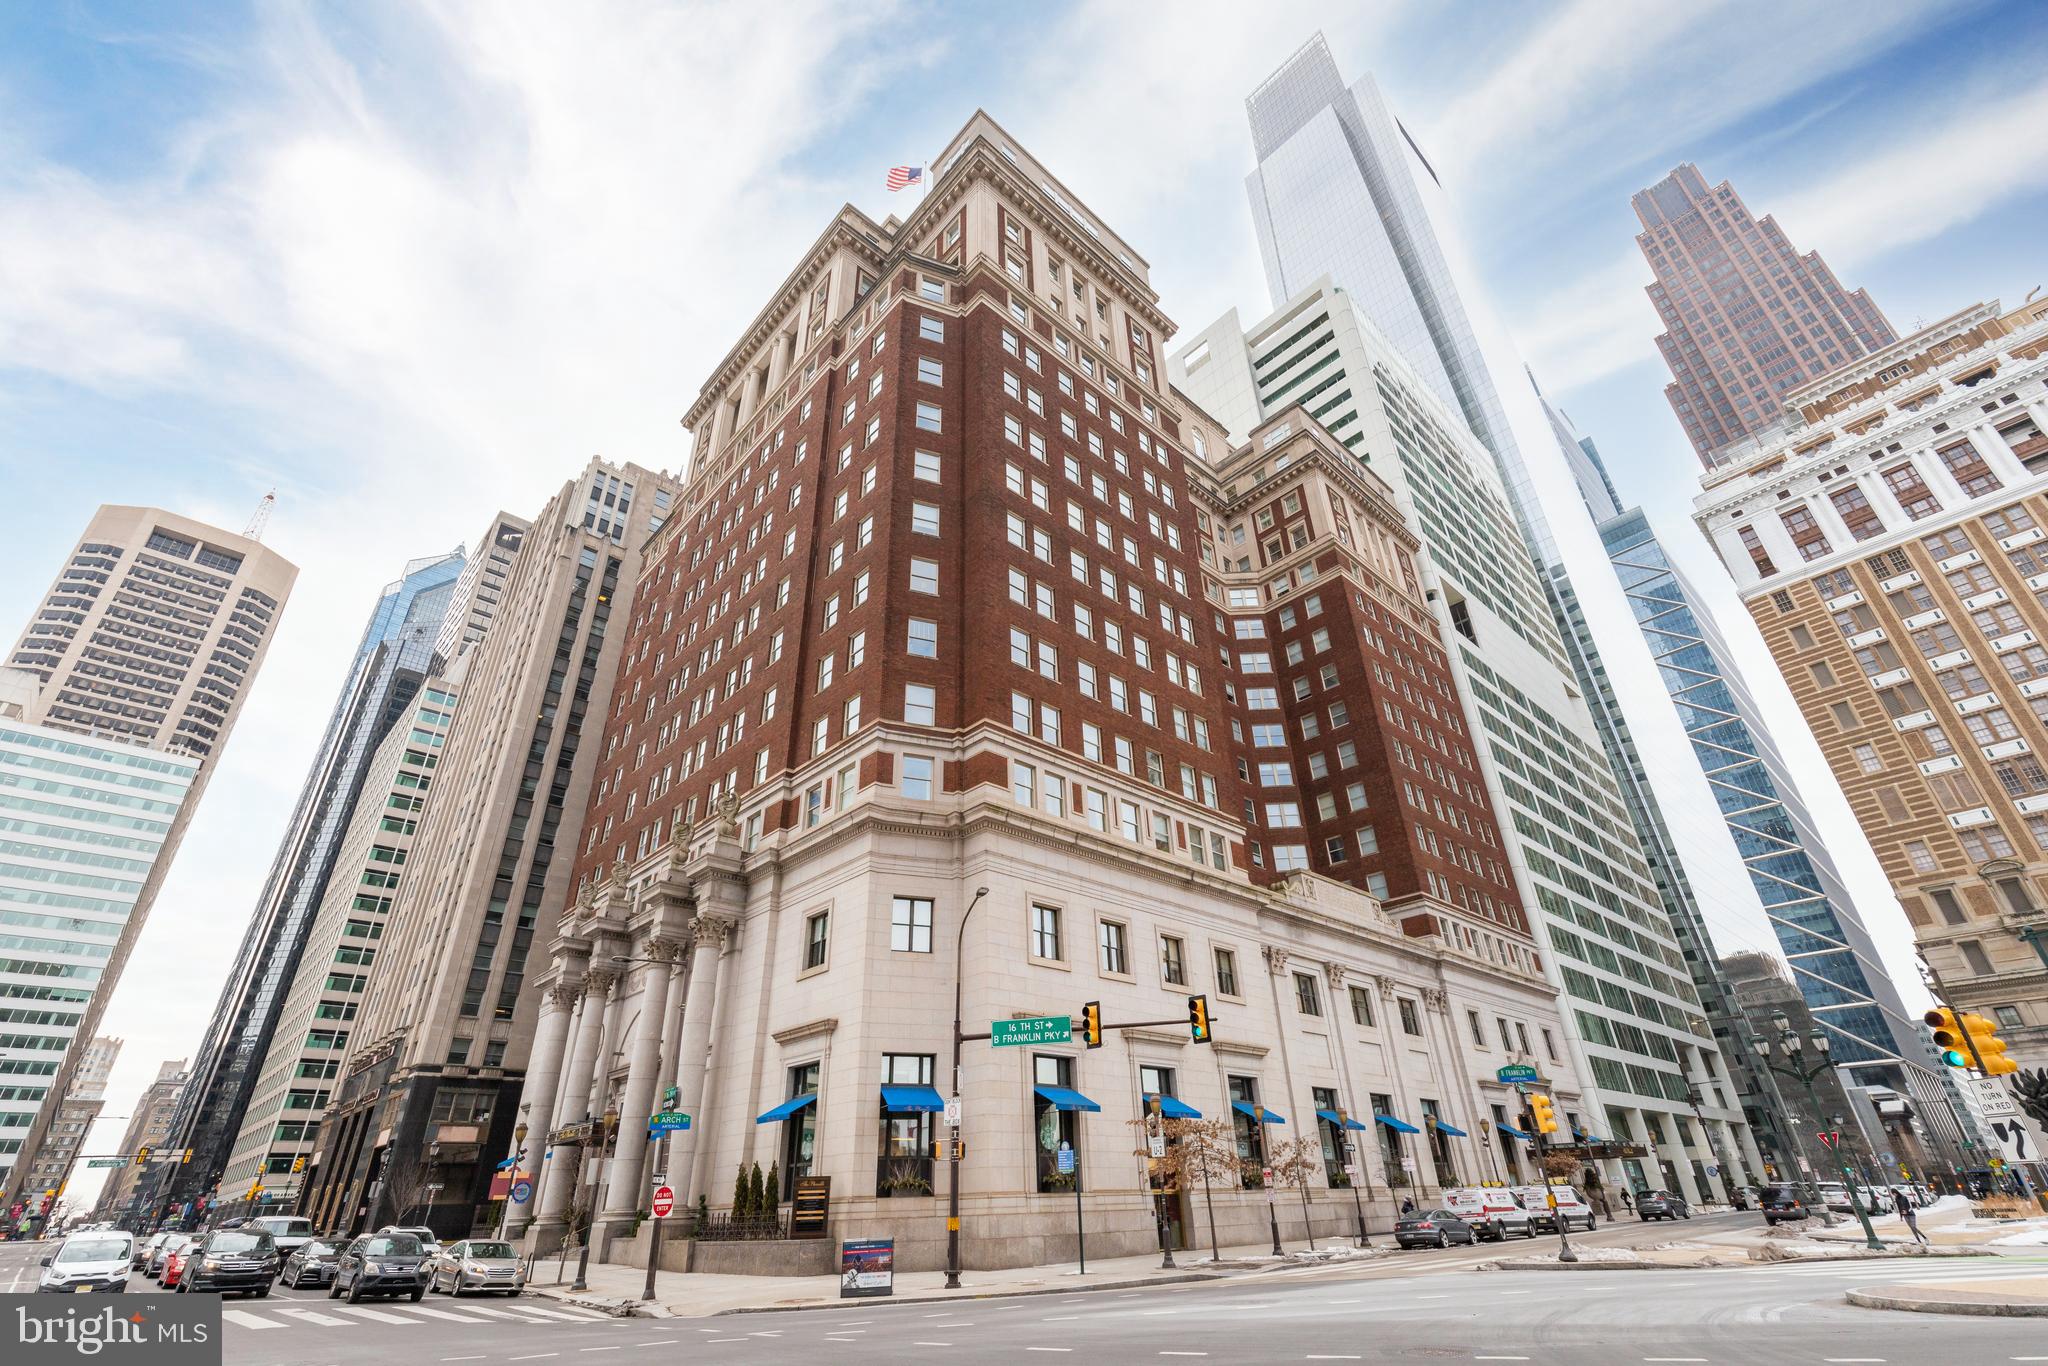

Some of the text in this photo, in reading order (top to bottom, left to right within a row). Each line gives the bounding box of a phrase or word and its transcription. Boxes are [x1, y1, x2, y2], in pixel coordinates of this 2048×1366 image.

[1020, 1022, 1030, 1030] TH
[1035, 1021, 1044, 1030] ST
[994, 1031, 1060, 1043] B FRANKLIN PKY
[1981, 1092, 2002, 1100] TURN
[1983, 1102, 2011, 1111] ON RED
[1154, 1145, 1162, 1155] U-2
